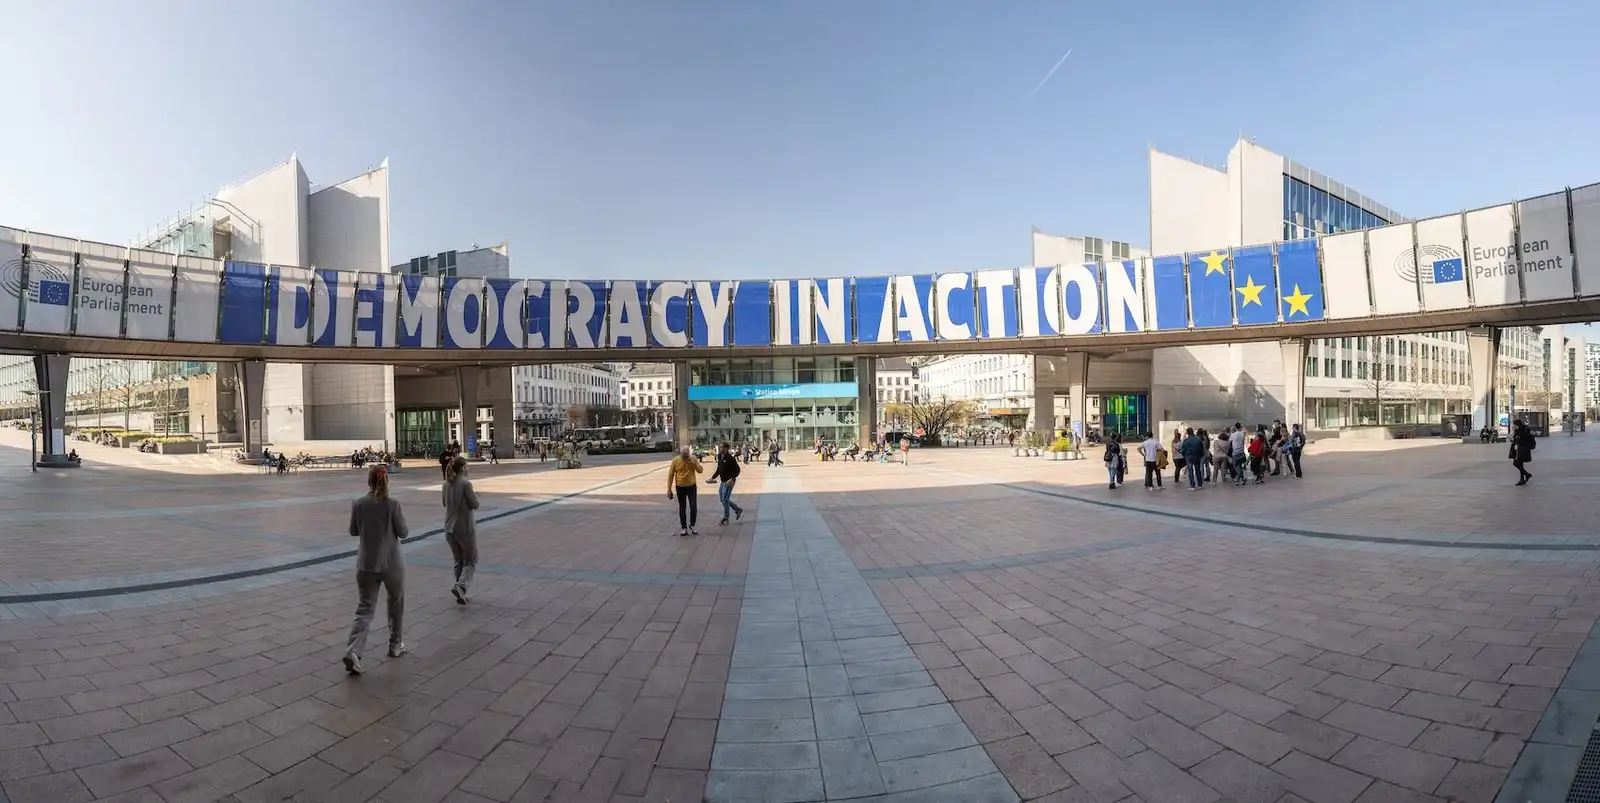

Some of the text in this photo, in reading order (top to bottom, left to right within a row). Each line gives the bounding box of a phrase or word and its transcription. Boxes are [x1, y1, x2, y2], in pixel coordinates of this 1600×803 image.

[1473, 239, 1549, 261] European
[1475, 255, 1563, 279] Parliament
[82, 277, 153, 297] European
[81, 296, 163, 315] Parliament
[276, 258, 1157, 348] DEMOCRACY IN ACTION
